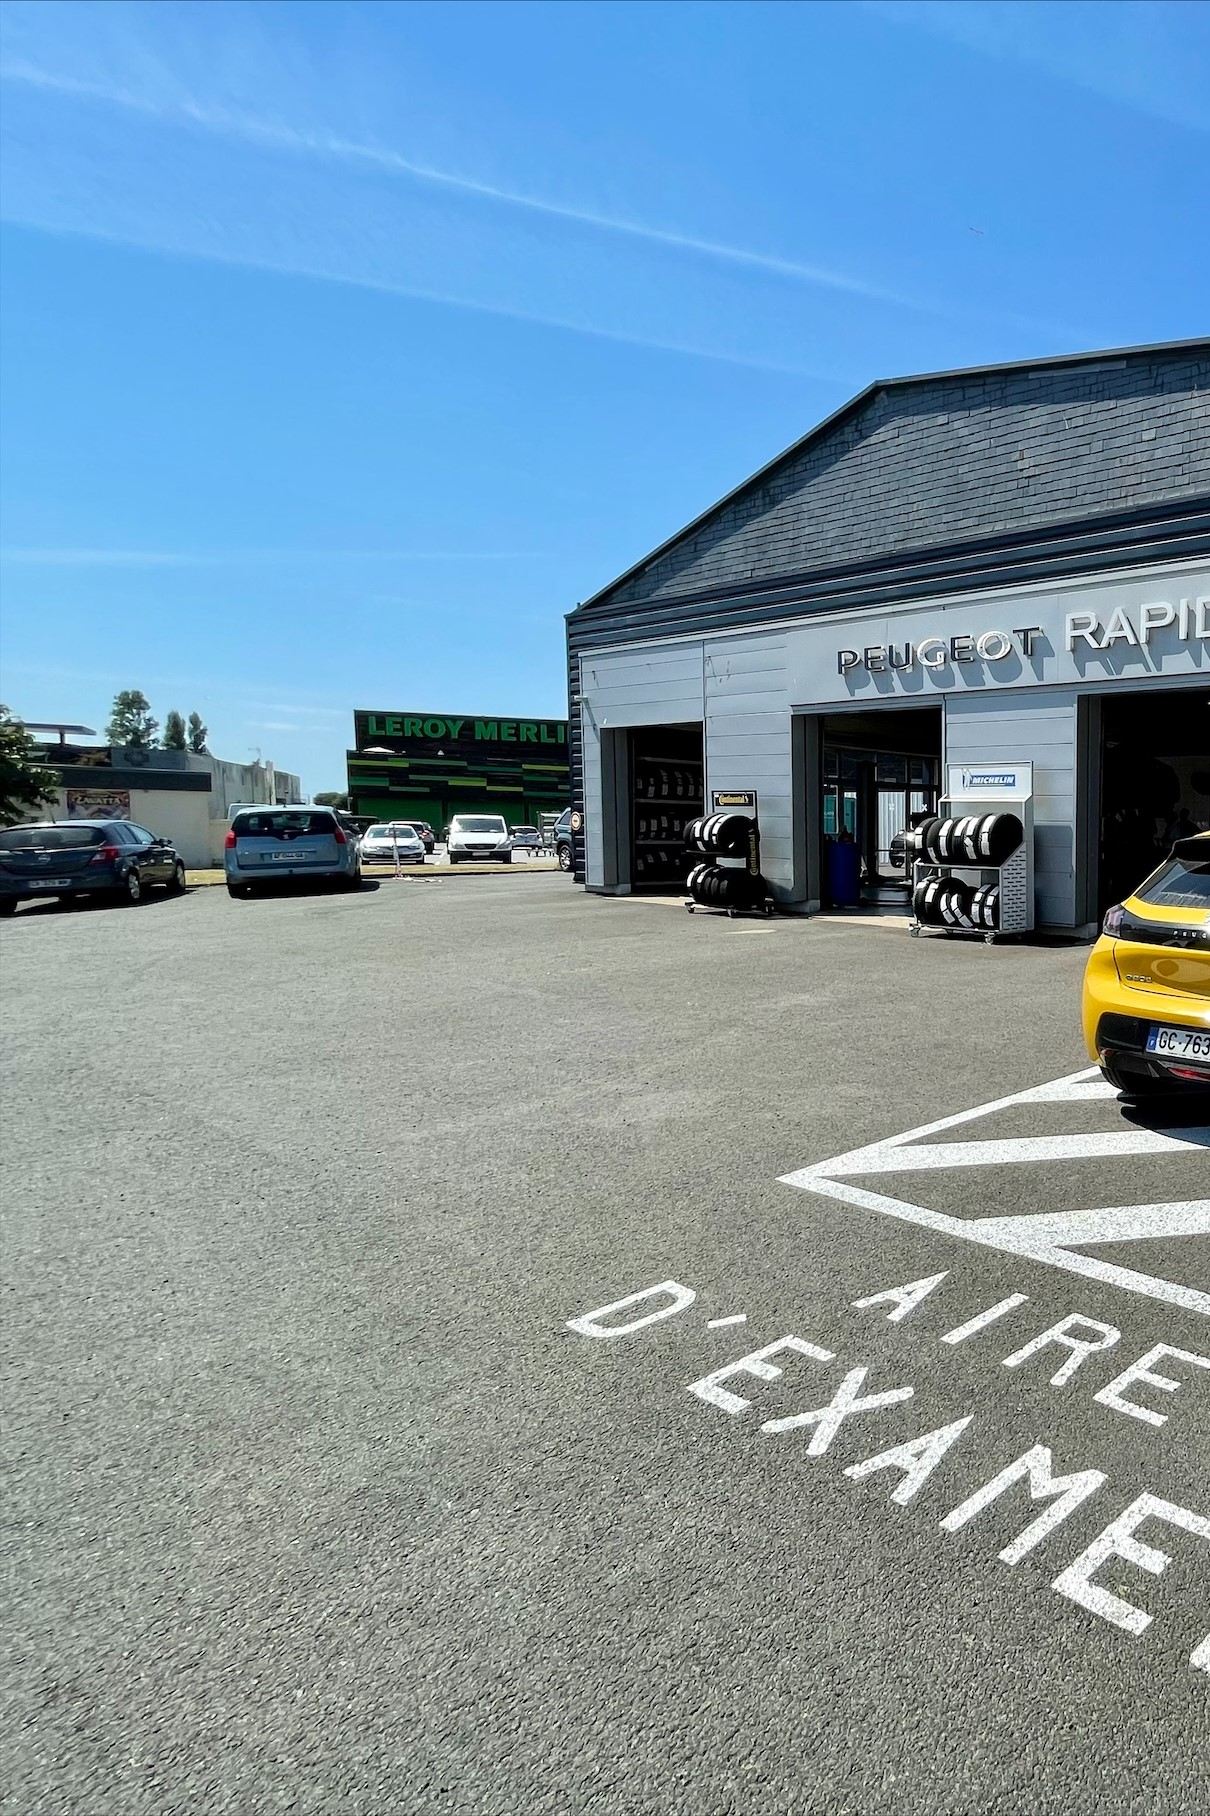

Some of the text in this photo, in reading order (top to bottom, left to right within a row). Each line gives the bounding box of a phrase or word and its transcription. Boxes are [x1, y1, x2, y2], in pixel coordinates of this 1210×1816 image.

[837, 626, 1044, 675] PEUGEOT
[367, 716, 569, 744] LEROY MERLI
[972, 776, 1014, 784] MICHELIN
